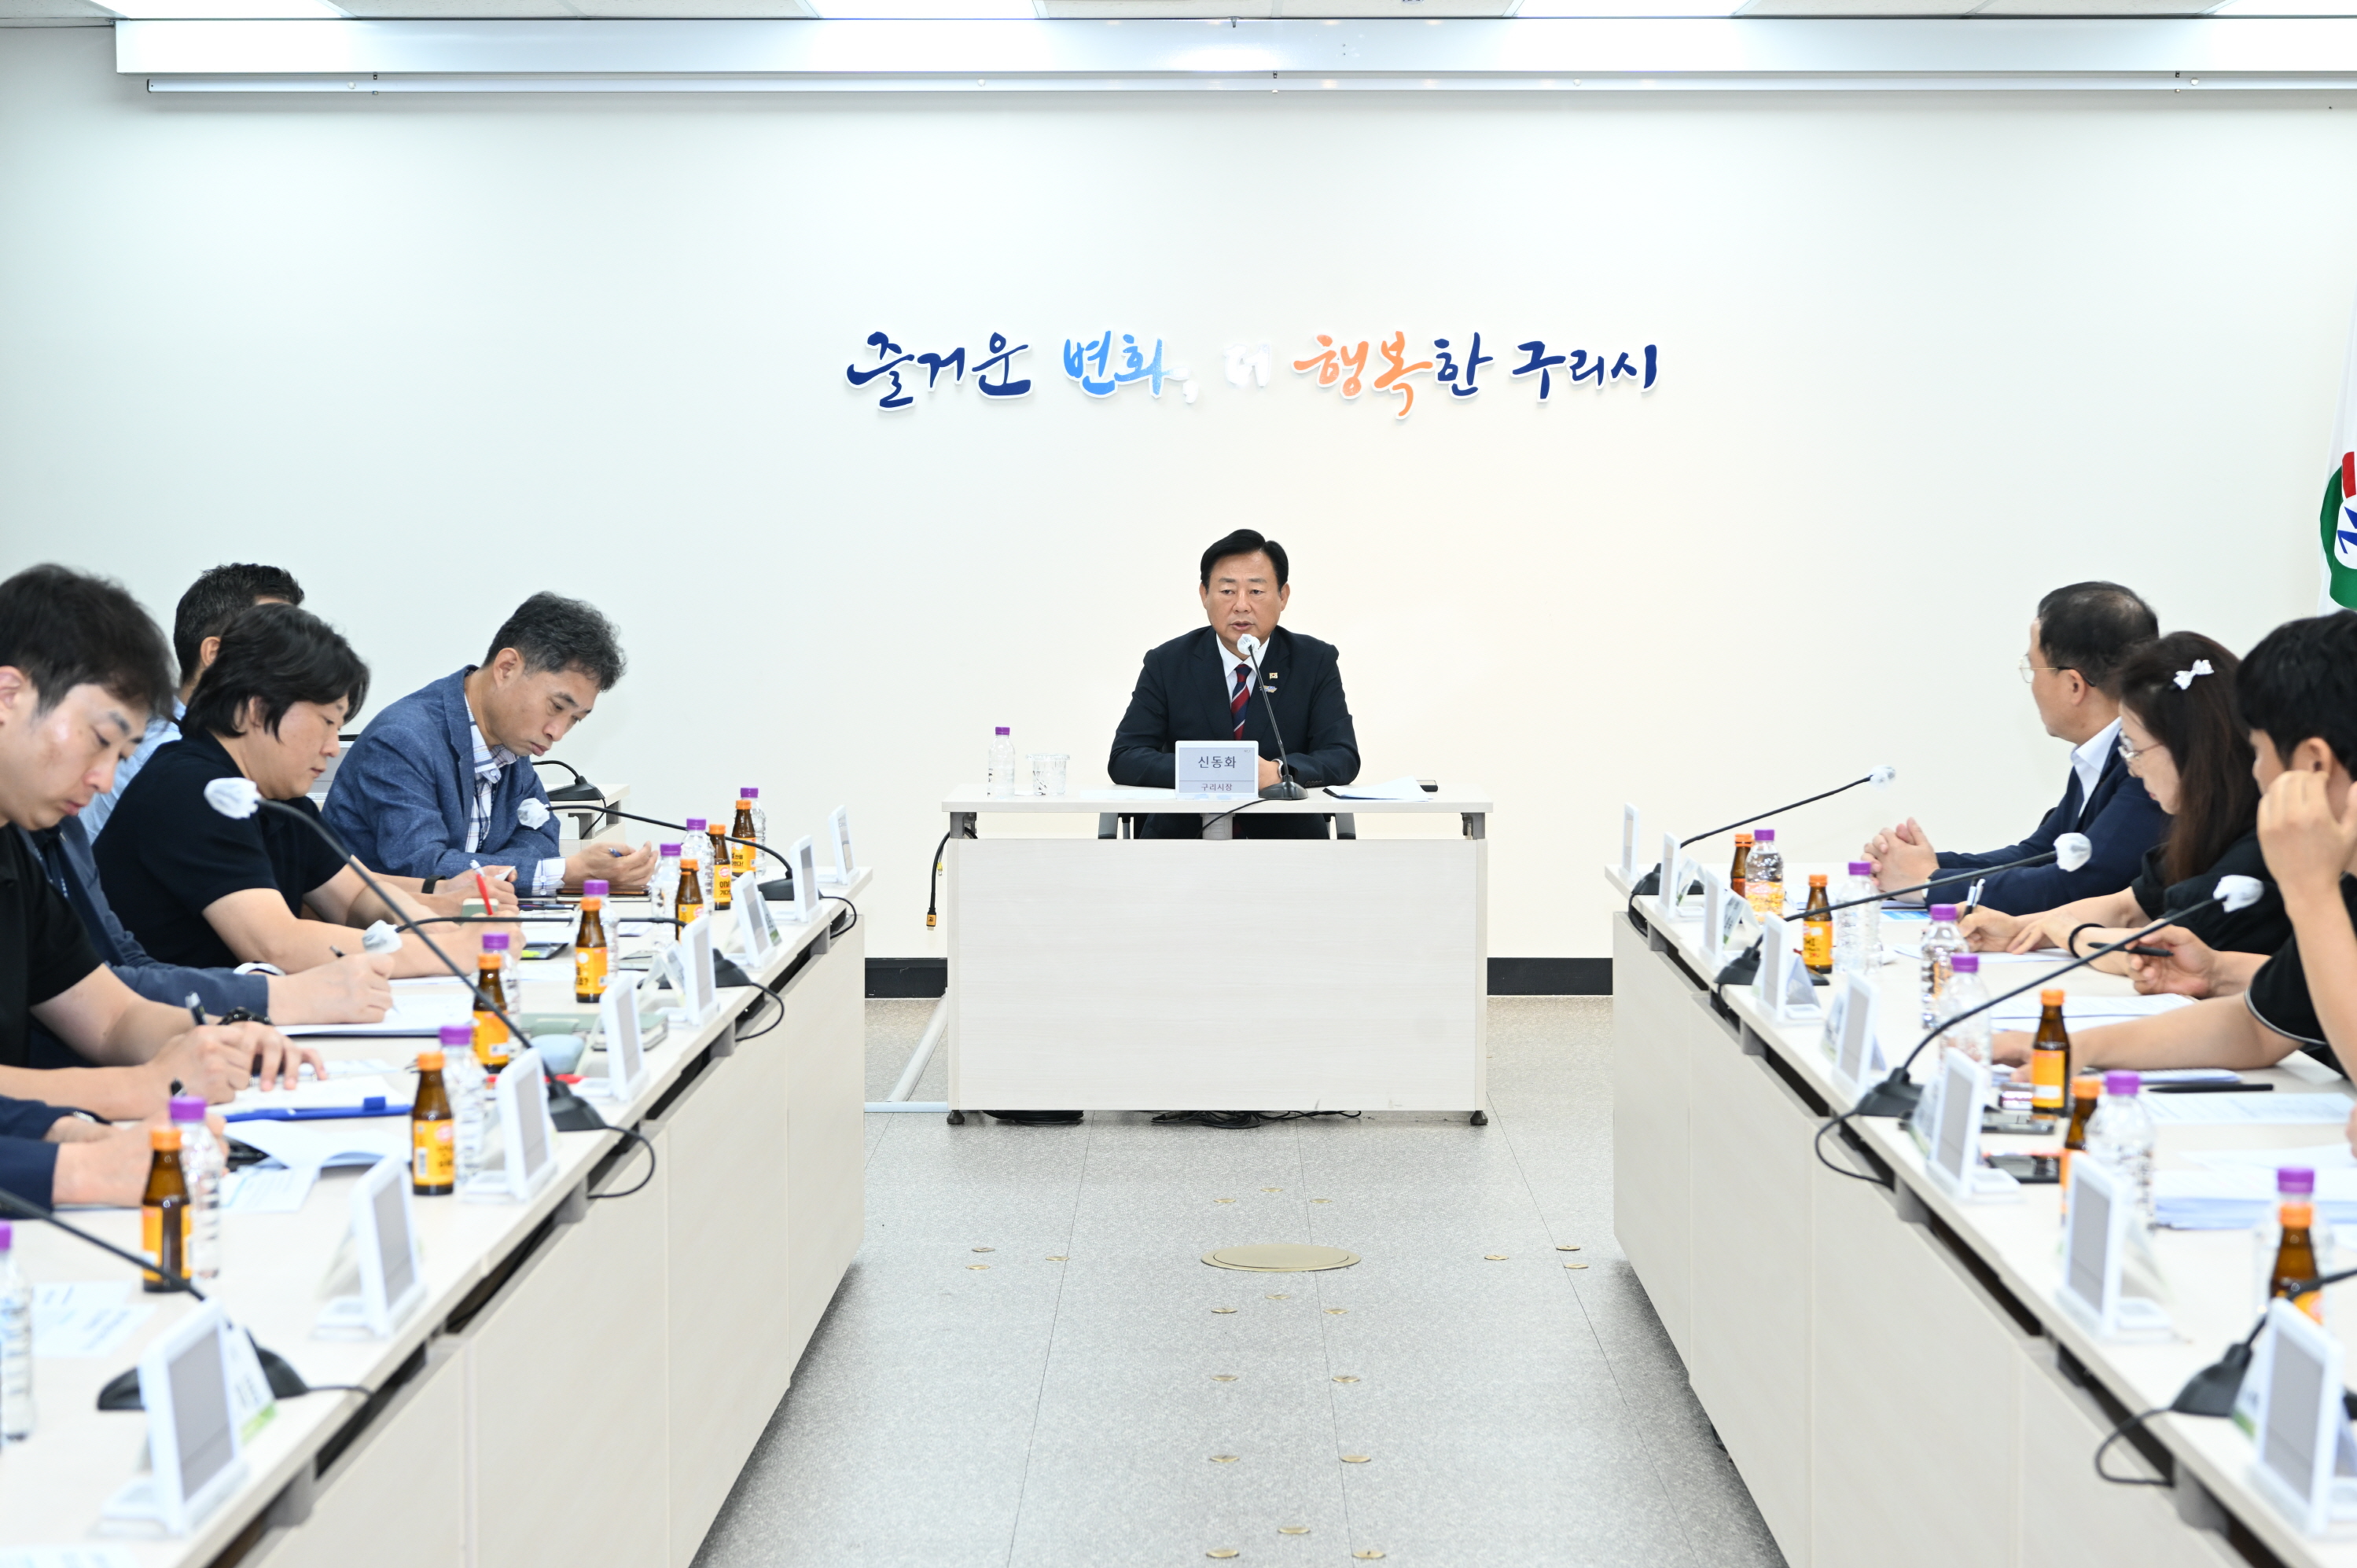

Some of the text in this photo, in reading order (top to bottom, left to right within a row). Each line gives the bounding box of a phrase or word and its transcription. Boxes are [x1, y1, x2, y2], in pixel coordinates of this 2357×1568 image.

[844, 329, 1033, 410] 즐거운
[1292, 332, 1495, 418] 행복한
[1510, 339, 1659, 401] 구리시
[1197, 755, 1237, 769] 신동화
[1201, 783, 1233, 791] 구리시장
